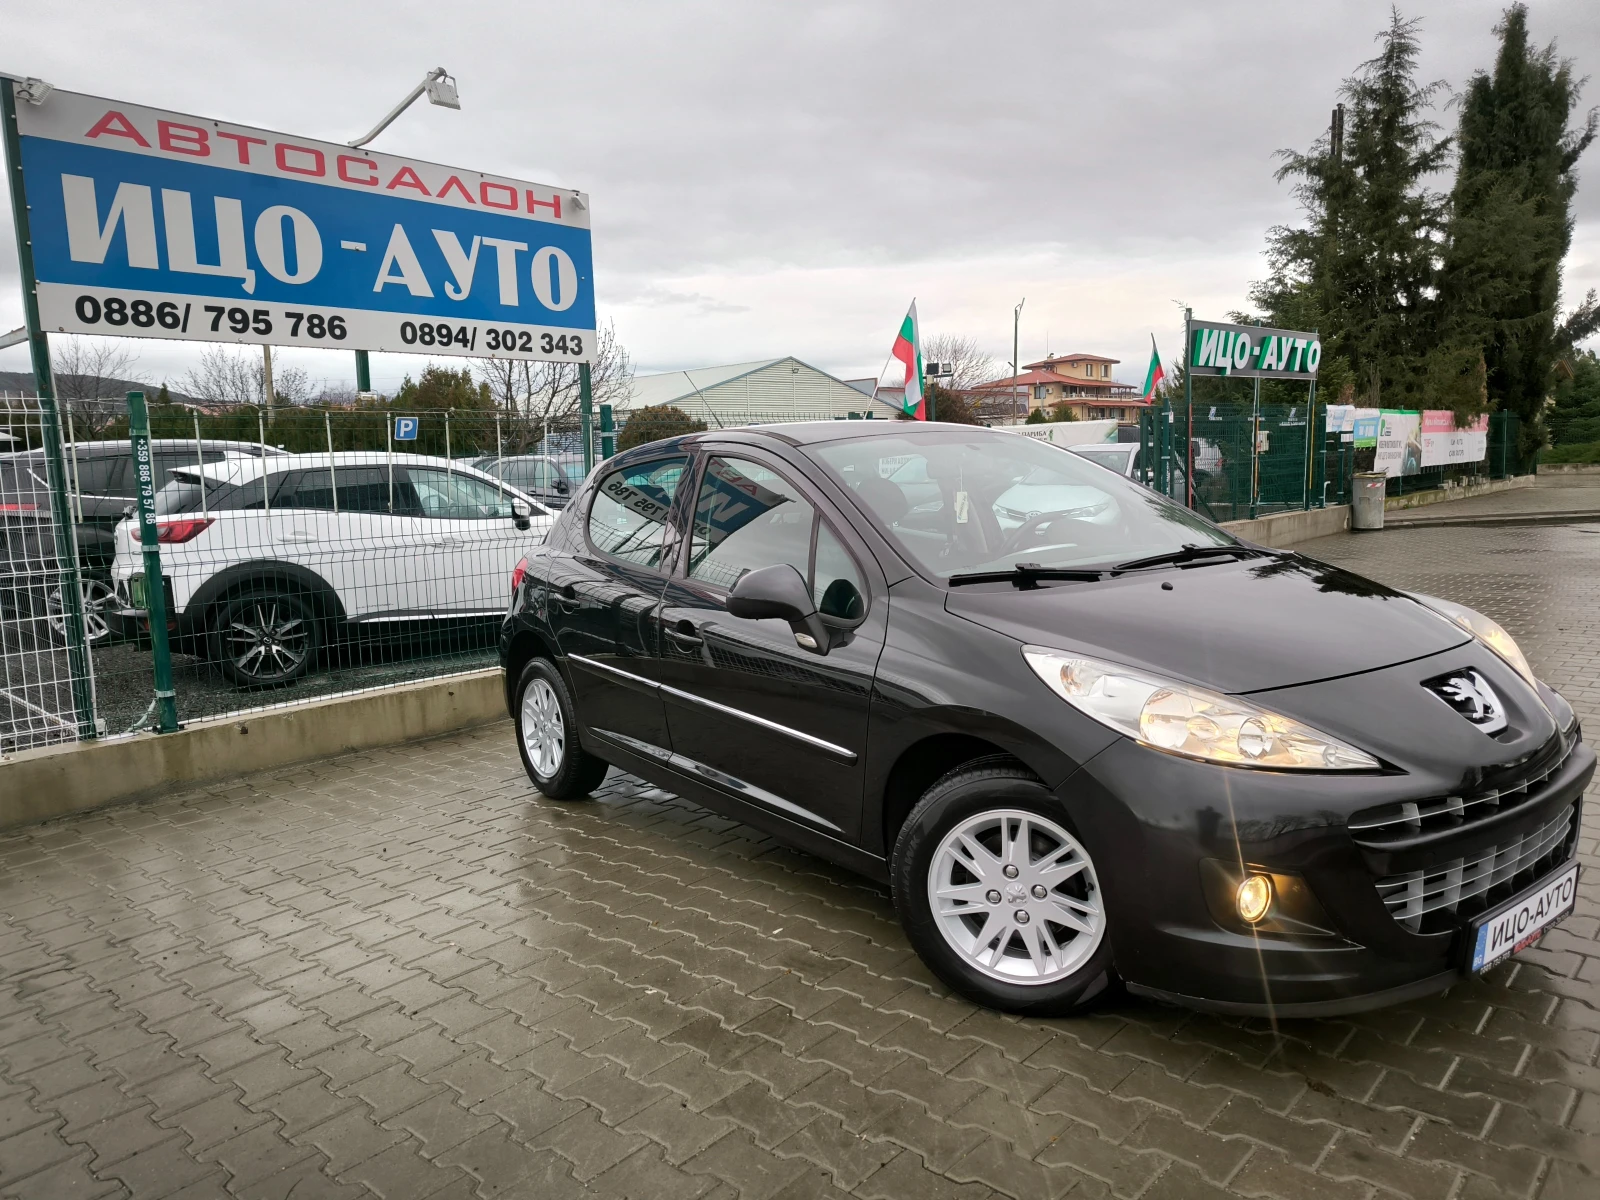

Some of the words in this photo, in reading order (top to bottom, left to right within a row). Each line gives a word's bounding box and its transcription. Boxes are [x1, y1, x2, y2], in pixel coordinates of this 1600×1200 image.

[84, 110, 562, 218] АВТОСАЛОН
[75, 295, 191, 333] 0886/
[204, 305, 273, 335] 795
[285, 311, 347, 340] 786
[400, 321, 477, 351] 0894/
[485, 329, 533, 352] 302
[540, 333, 583, 356] 343
[1194, 328, 1321, 375] ИЦО-АУТО
[400, 420, 413, 437] P
[137, 439, 148, 462] +359
[139, 464, 151, 482] 886
[141, 484, 153, 496] 79
[143, 499, 155, 510] 57
[145, 512, 156, 525] 86
[1491, 877, 1572, 952] ИЦО-АУТО
[1473, 955, 1482, 966] BG
